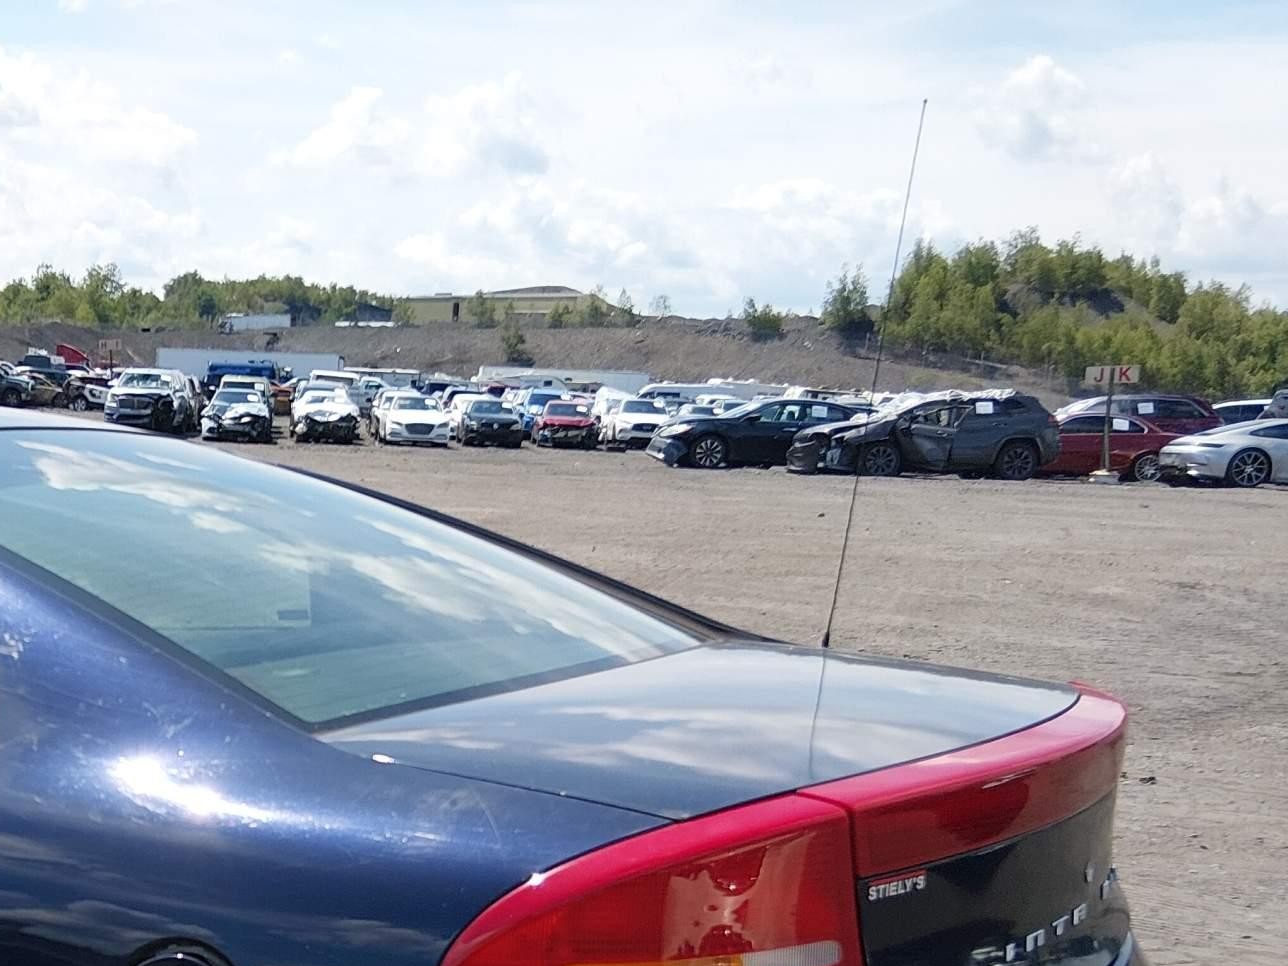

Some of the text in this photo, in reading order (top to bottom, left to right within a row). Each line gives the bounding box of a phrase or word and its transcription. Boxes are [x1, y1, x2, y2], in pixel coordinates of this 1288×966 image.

[1094, 366, 1132, 383] J K
[868, 875, 926, 901] STIELY'S
